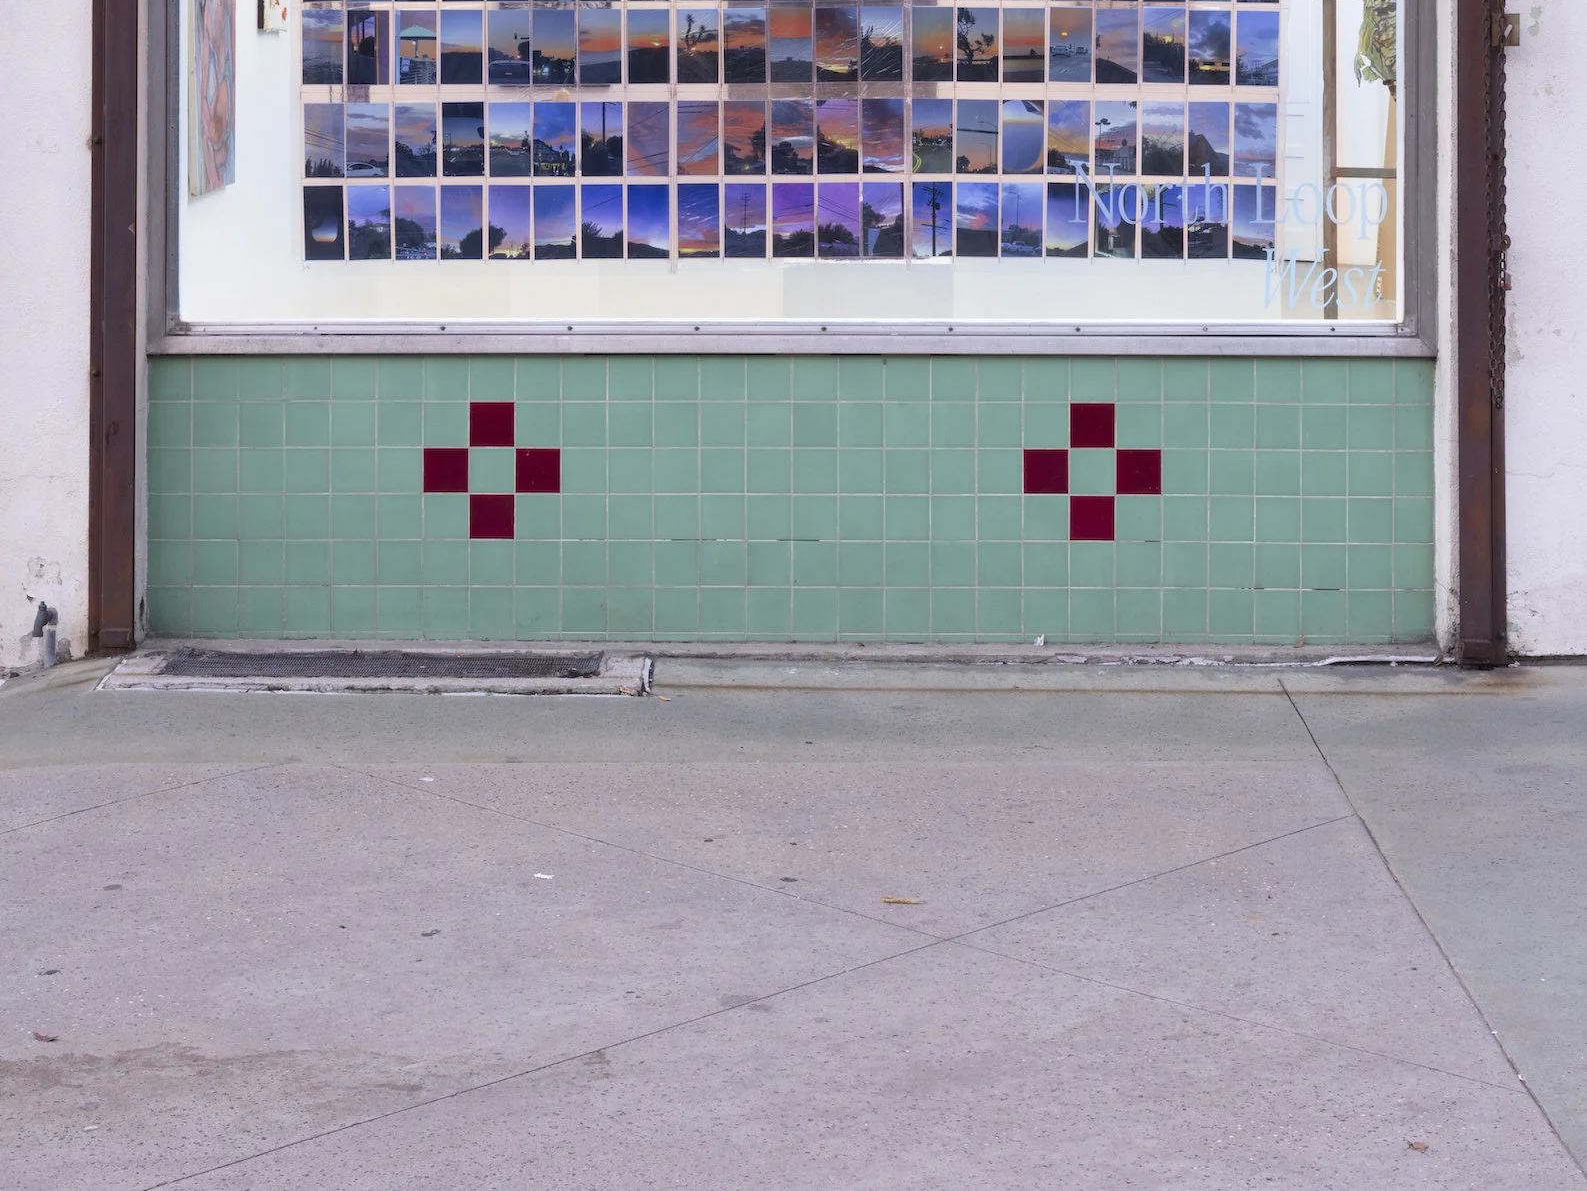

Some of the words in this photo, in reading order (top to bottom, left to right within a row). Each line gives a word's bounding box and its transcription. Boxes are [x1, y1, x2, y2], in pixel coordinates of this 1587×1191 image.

[1067, 161, 1231, 225] North
[1249, 162, 1388, 240] Loop
[1262, 247, 1387, 310] West
